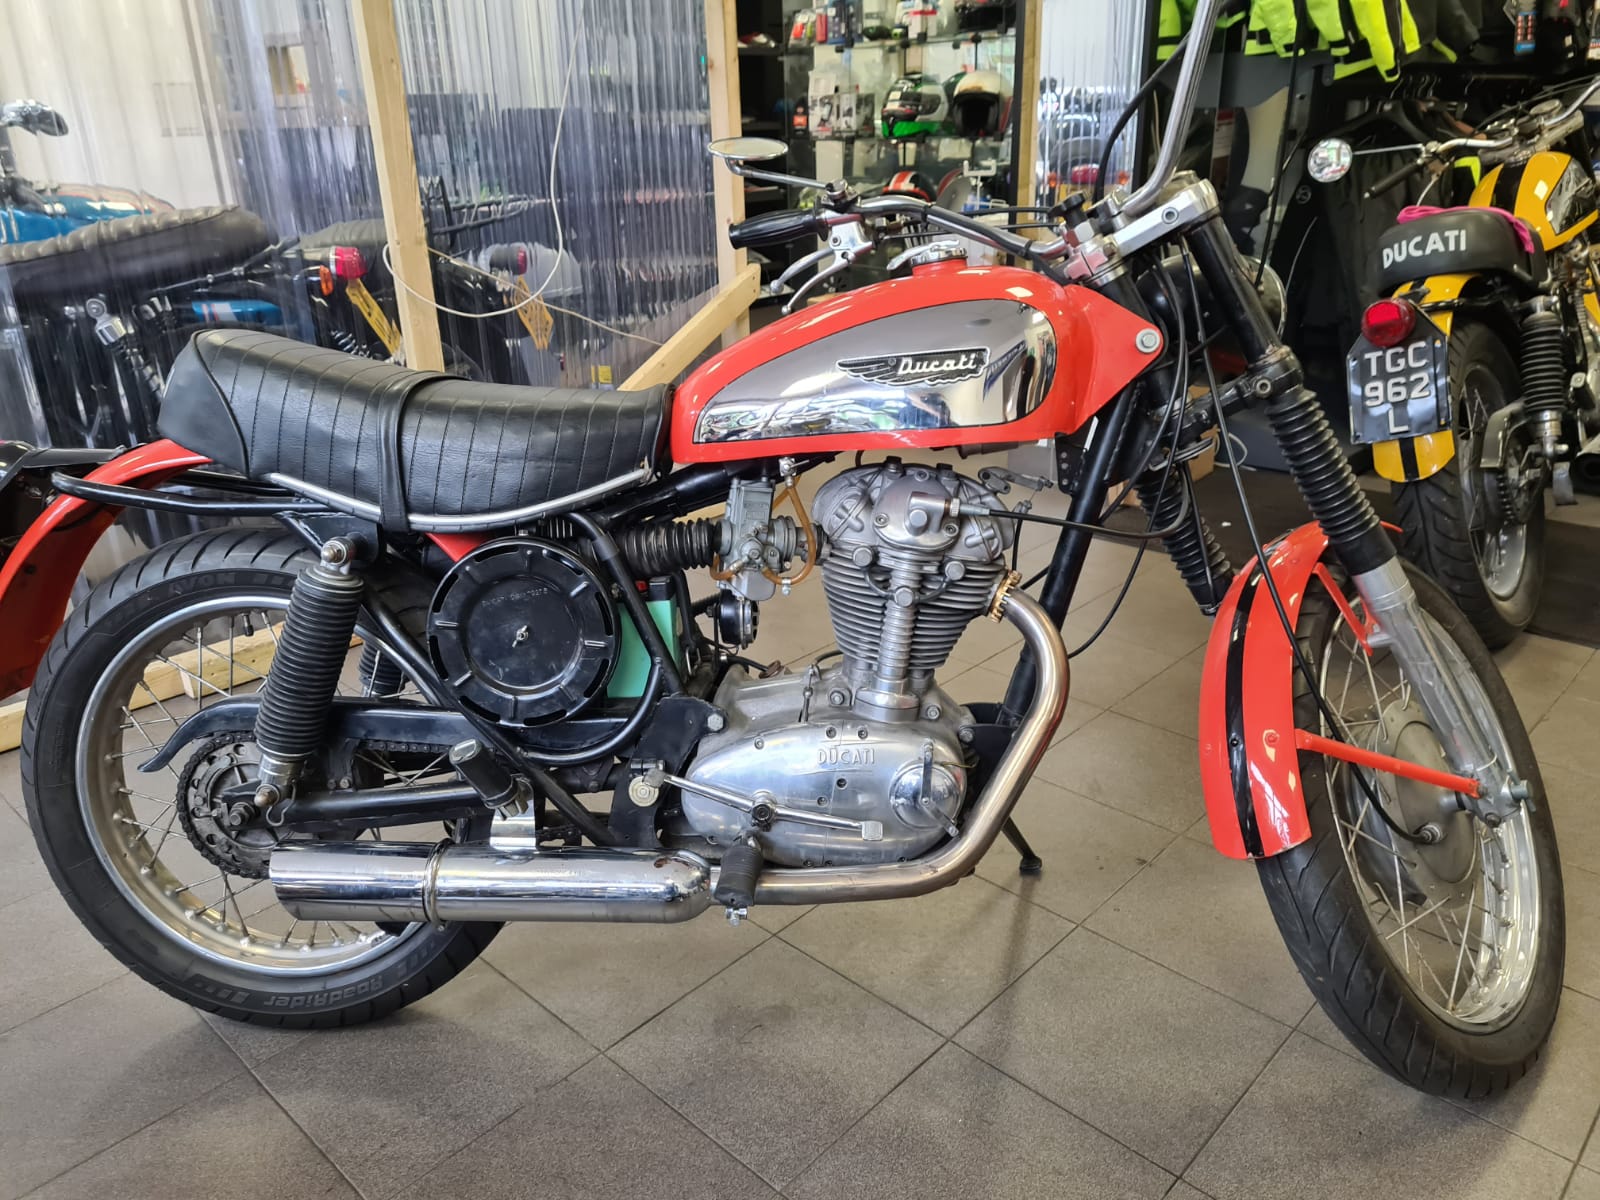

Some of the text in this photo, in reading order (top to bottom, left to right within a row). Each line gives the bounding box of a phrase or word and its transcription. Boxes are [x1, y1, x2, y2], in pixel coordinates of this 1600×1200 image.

[1382, 229, 1467, 269] DUCATI
[897, 353, 977, 376] Ducati
[1364, 340, 1428, 377] TGC
[1364, 371, 1430, 407] 962
[1387, 408, 1409, 434] L
[817, 747, 875, 765] DUCATI
[264, 976, 384, 1009] RoadRider
